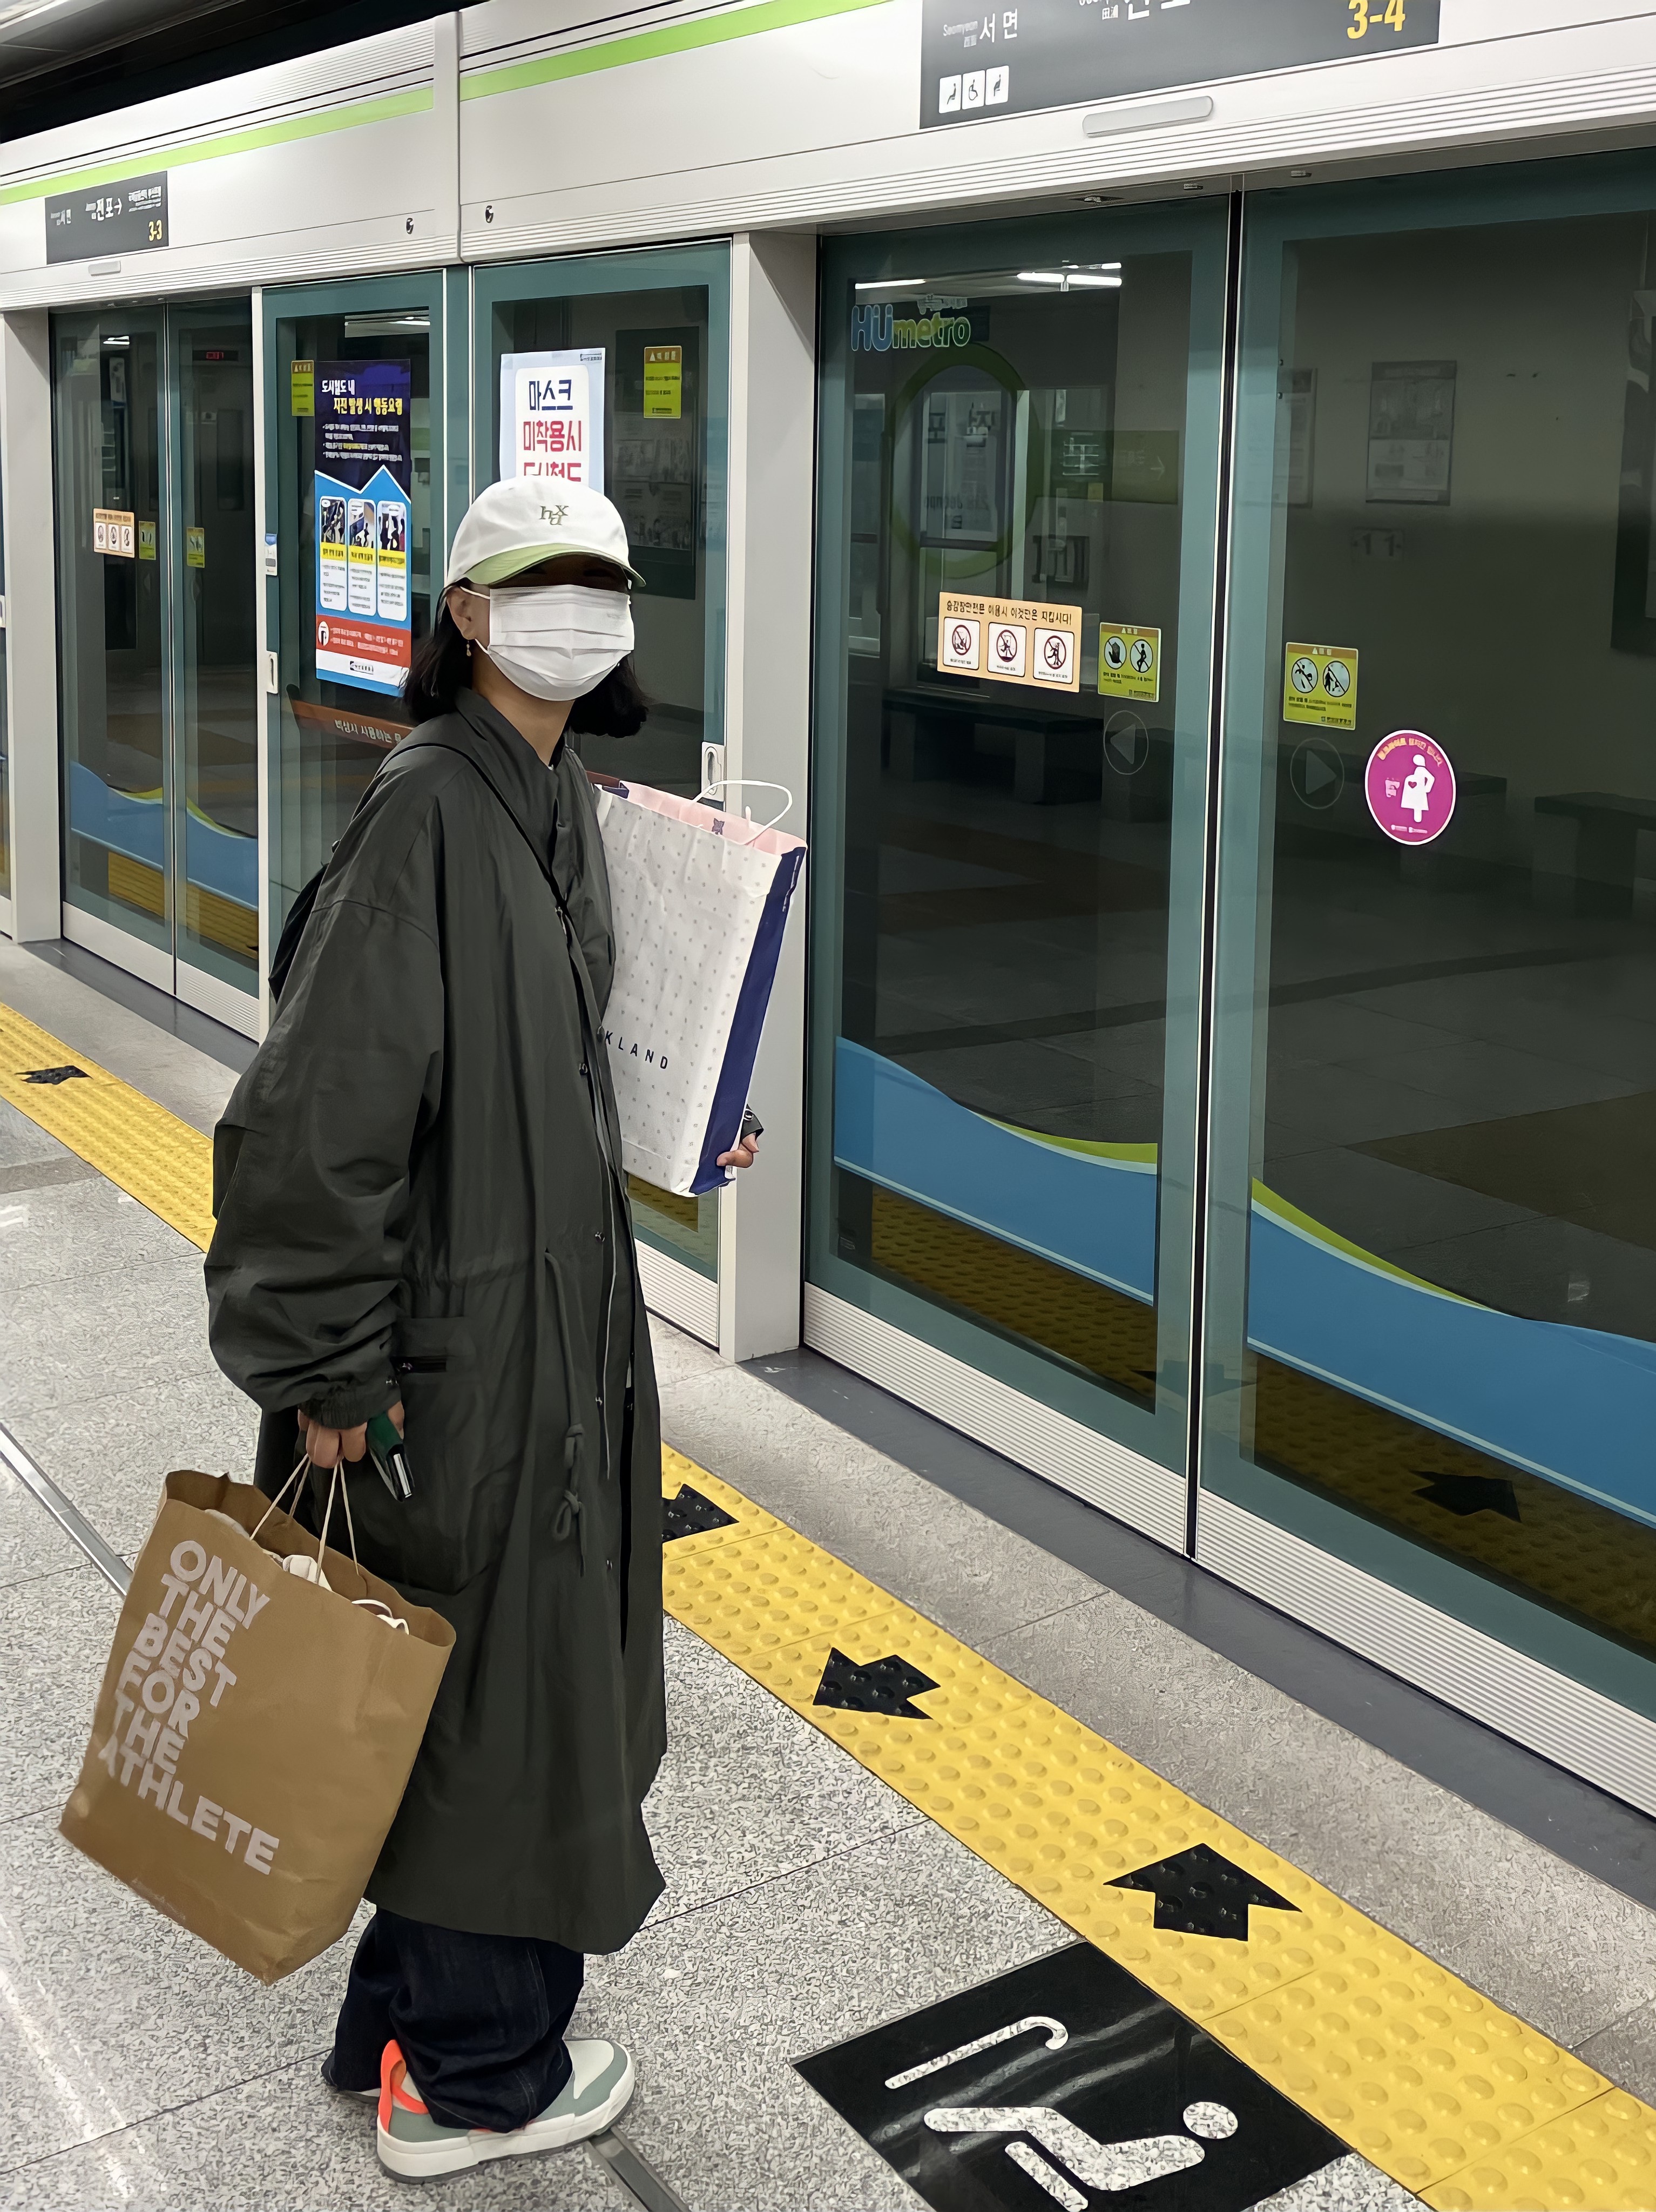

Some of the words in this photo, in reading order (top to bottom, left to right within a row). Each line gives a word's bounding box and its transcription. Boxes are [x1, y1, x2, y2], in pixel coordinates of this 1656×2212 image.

[979, 8, 1018, 43] 서면
[1347, 0, 1405, 39] 3-4
[148, 220, 162, 241] 3-3
[523, 420, 582, 452] 미착용시
[529, 380, 573, 410] 마스크
[160, 1573, 236, 1660] THE
[170, 1540, 270, 1629] ONLY
[116, 1650, 200, 1740] FOR
[134, 1613, 237, 1707] BEST
[113, 1689, 185, 1775] THE
[98, 1734, 279, 1875] ATHLETE
